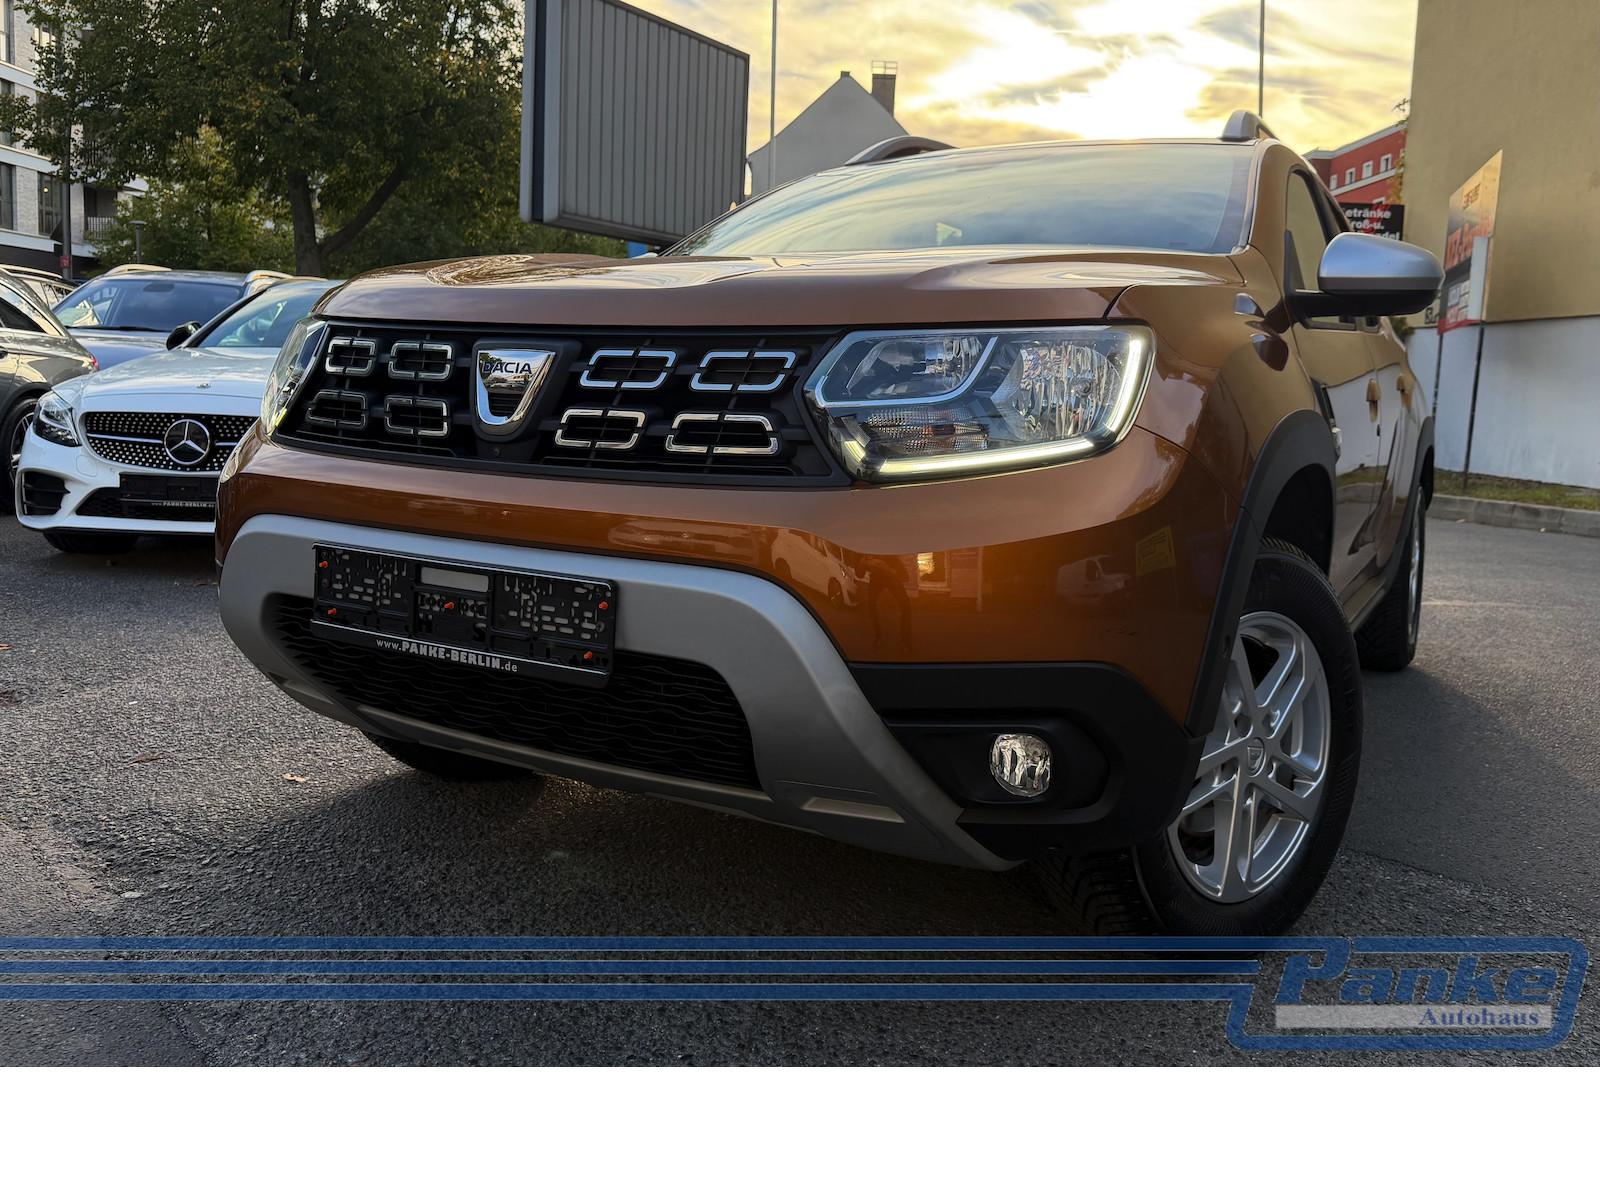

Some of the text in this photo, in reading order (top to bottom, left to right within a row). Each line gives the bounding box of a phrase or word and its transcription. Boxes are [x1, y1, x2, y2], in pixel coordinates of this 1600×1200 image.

[1343, 207, 1392, 219] etränke
[1350, 219, 1385, 230] roß-u.
[482, 361, 532, 374] DACIA
[376, 639, 518, 672] www.PANKE-BERLIN.de
